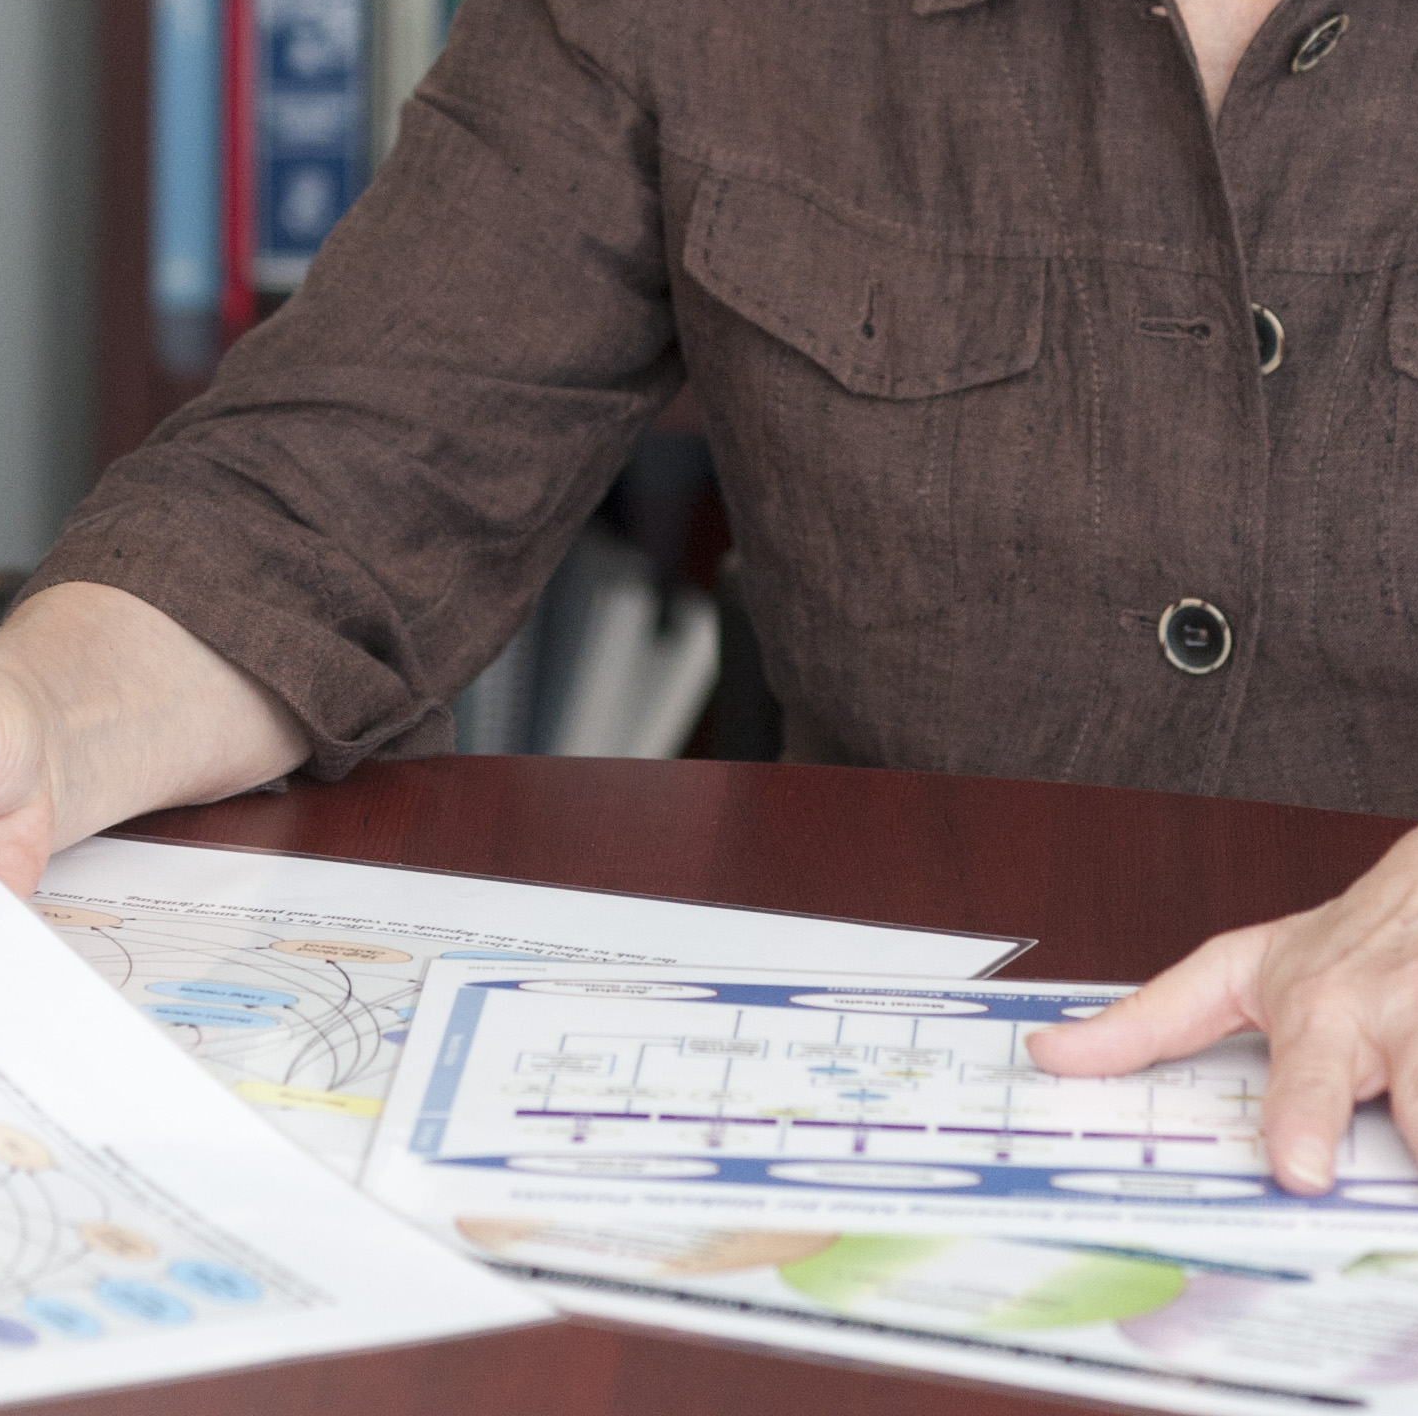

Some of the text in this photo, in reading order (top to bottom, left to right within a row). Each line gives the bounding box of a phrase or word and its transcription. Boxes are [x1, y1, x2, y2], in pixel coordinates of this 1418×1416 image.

[122, 902, 179, 912] women
[221, 905, 286, 915] patterns
[377, 927, 462, 940] protective
[413, 925, 480, 937] depends
[523, 940, 589, 953] diabetes
